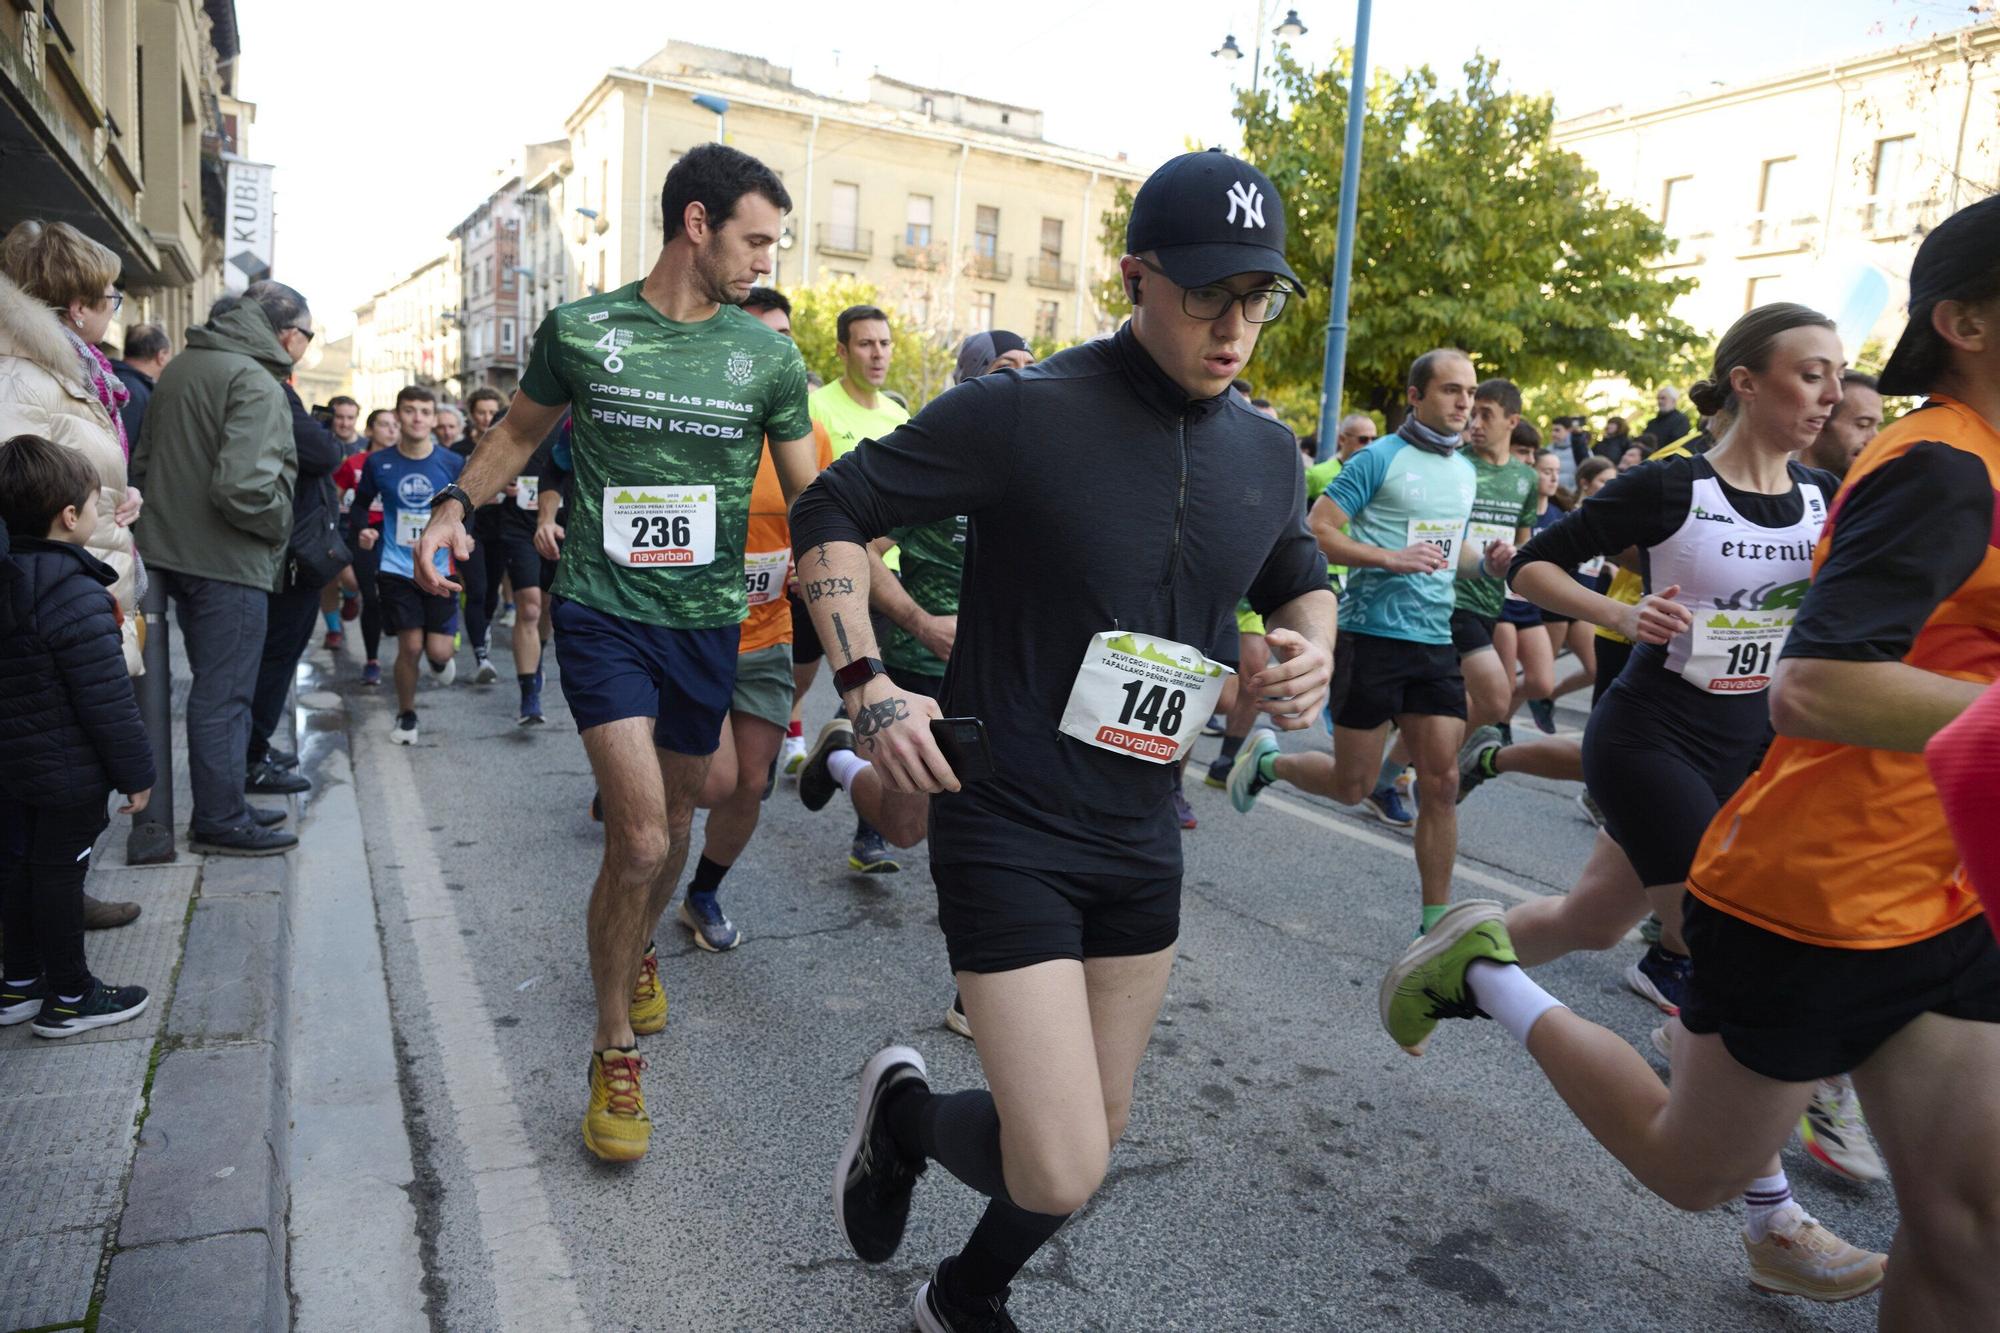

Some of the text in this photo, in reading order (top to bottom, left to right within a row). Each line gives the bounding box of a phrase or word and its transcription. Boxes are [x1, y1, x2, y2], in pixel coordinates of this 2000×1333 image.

[233, 168, 259, 243] KUBE
[589, 383, 754, 413] CROSS DE LAS PEÑAS
[591, 408, 743, 439] PEÑEN KROSA
[631, 516, 691, 548] 236
[633, 551, 692, 562] navarban
[745, 572, 770, 593] 59
[1102, 658, 1144, 676] TAFALLAKO
[1146, 671, 1168, 683] PEÑEN
[1129, 658, 1149, 669] CROSS
[1152, 664, 1173, 676] PEÑAS
[1726, 642, 1772, 675] 191
[1118, 680, 1186, 736] 148
